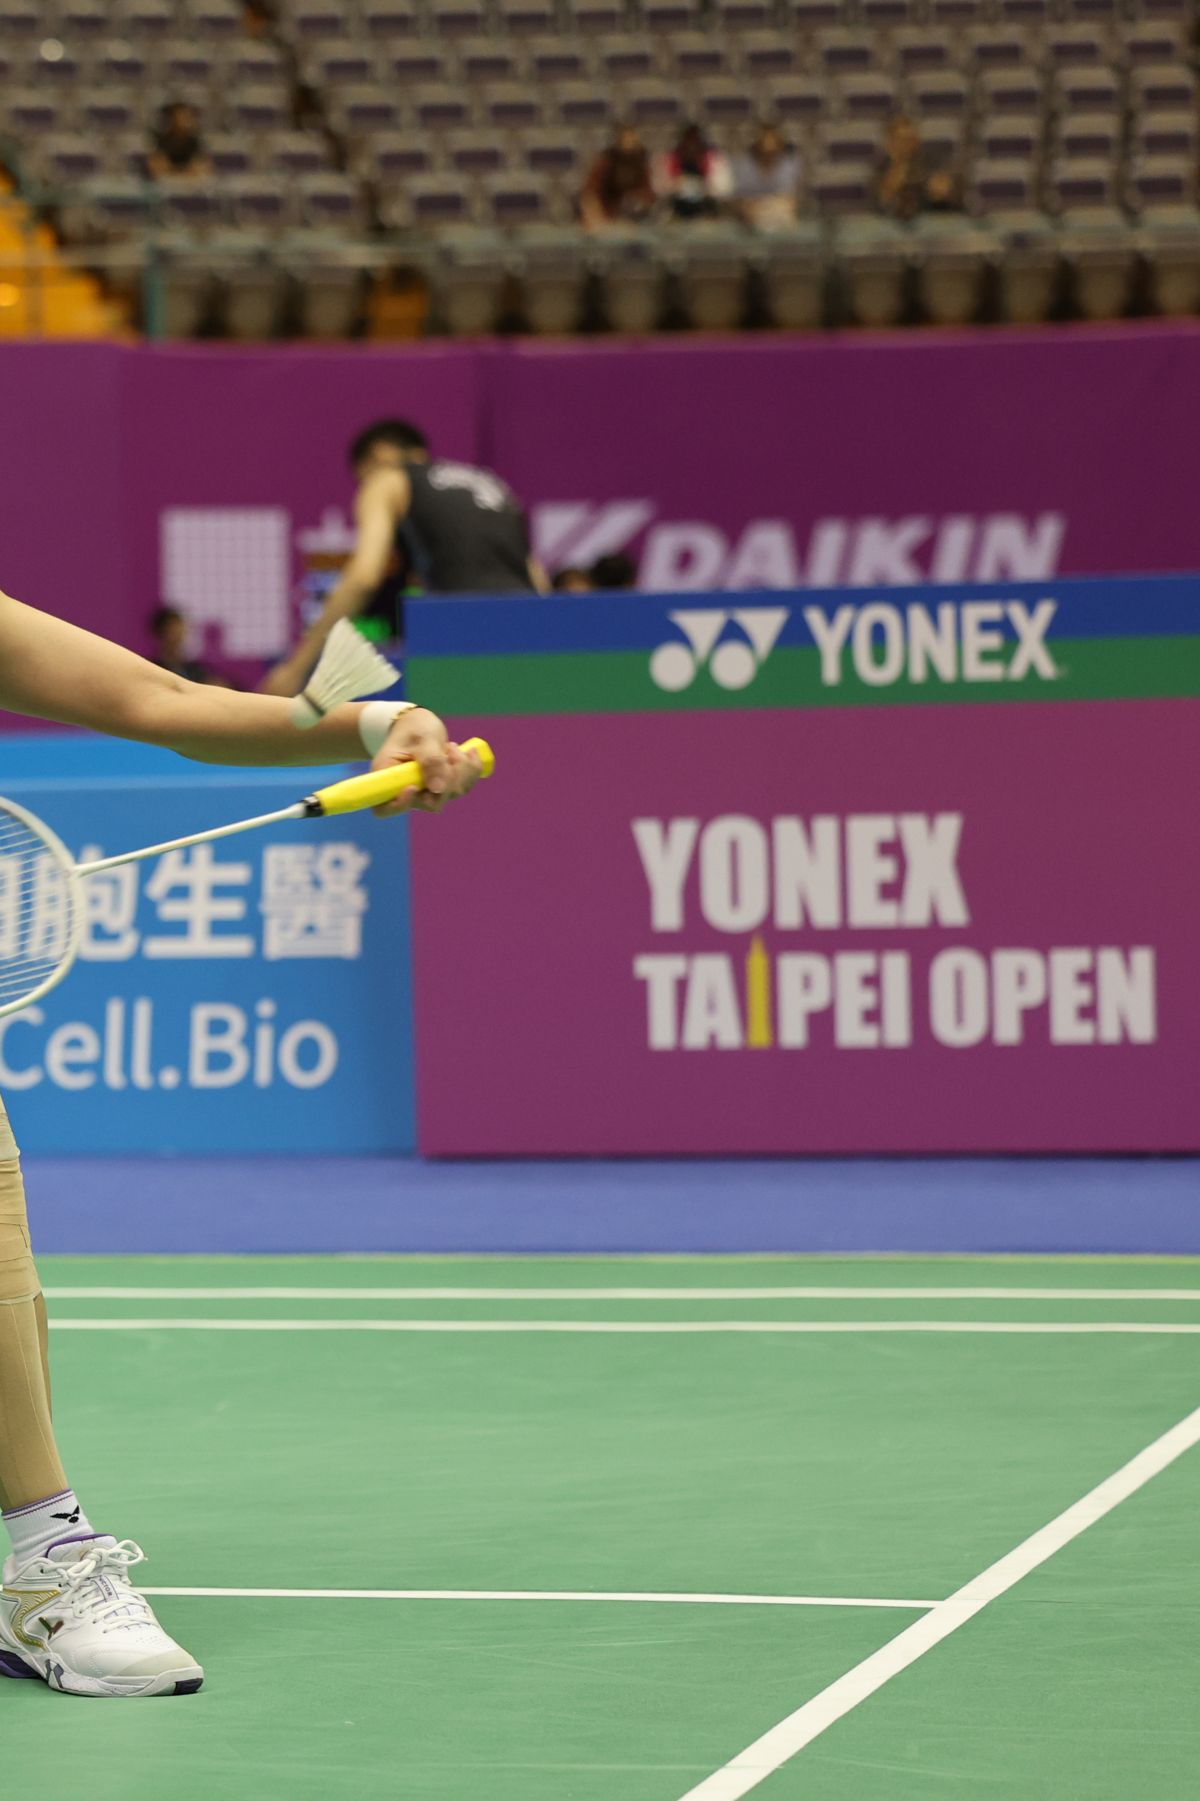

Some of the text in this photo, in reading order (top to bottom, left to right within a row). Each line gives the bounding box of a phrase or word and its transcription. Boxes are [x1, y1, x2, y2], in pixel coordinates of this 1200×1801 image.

[638, 512, 1066, 592] DAIKIN
[803, 599, 1058, 686] YONEX
[632, 813, 970, 932] YONEX
[634, 935, 1156, 1050] TAIPEI OPEN
